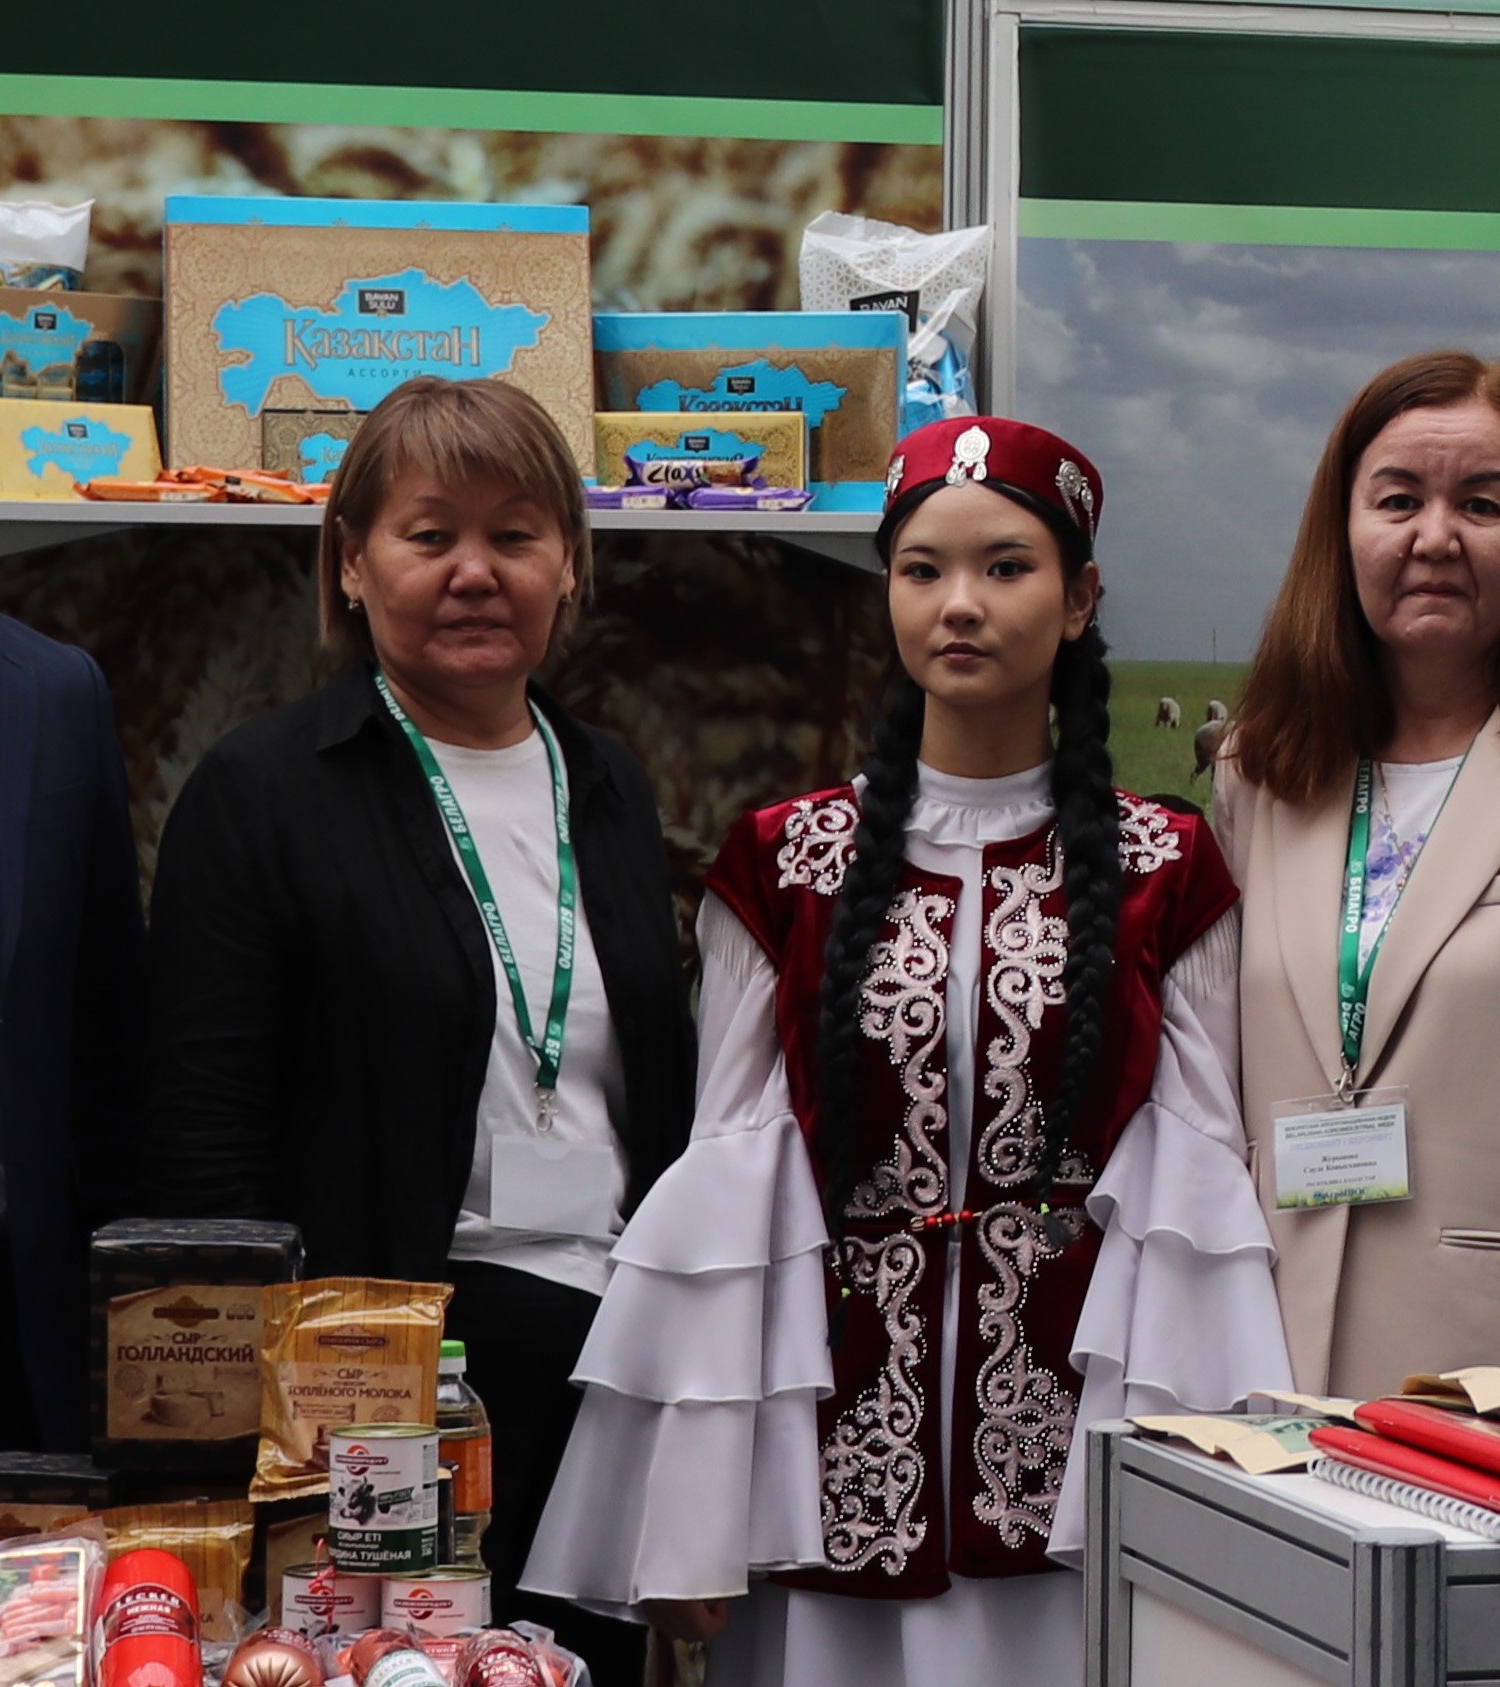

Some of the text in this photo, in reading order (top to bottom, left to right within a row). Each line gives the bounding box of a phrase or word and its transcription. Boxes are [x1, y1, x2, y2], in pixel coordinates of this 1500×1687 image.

[430, 775, 467, 834] БЕЛАГРО
[1345, 877, 1361, 934] БЕЛАГРО
[482, 901, 514, 964] БЕЛАГРО
[558, 905, 574, 970] БЕЛАГРО
[172, 1332, 201, 1344] СЫР
[117, 1344, 255, 1364] ГОЛЛАНДСКИЙ
[337, 1369, 364, 1380] СЫР
[288, 1384, 412, 1399] ТОПЛЁНОГО МОЛОКА
[360, 1549, 412, 1561] ТУШЁНАЯ
